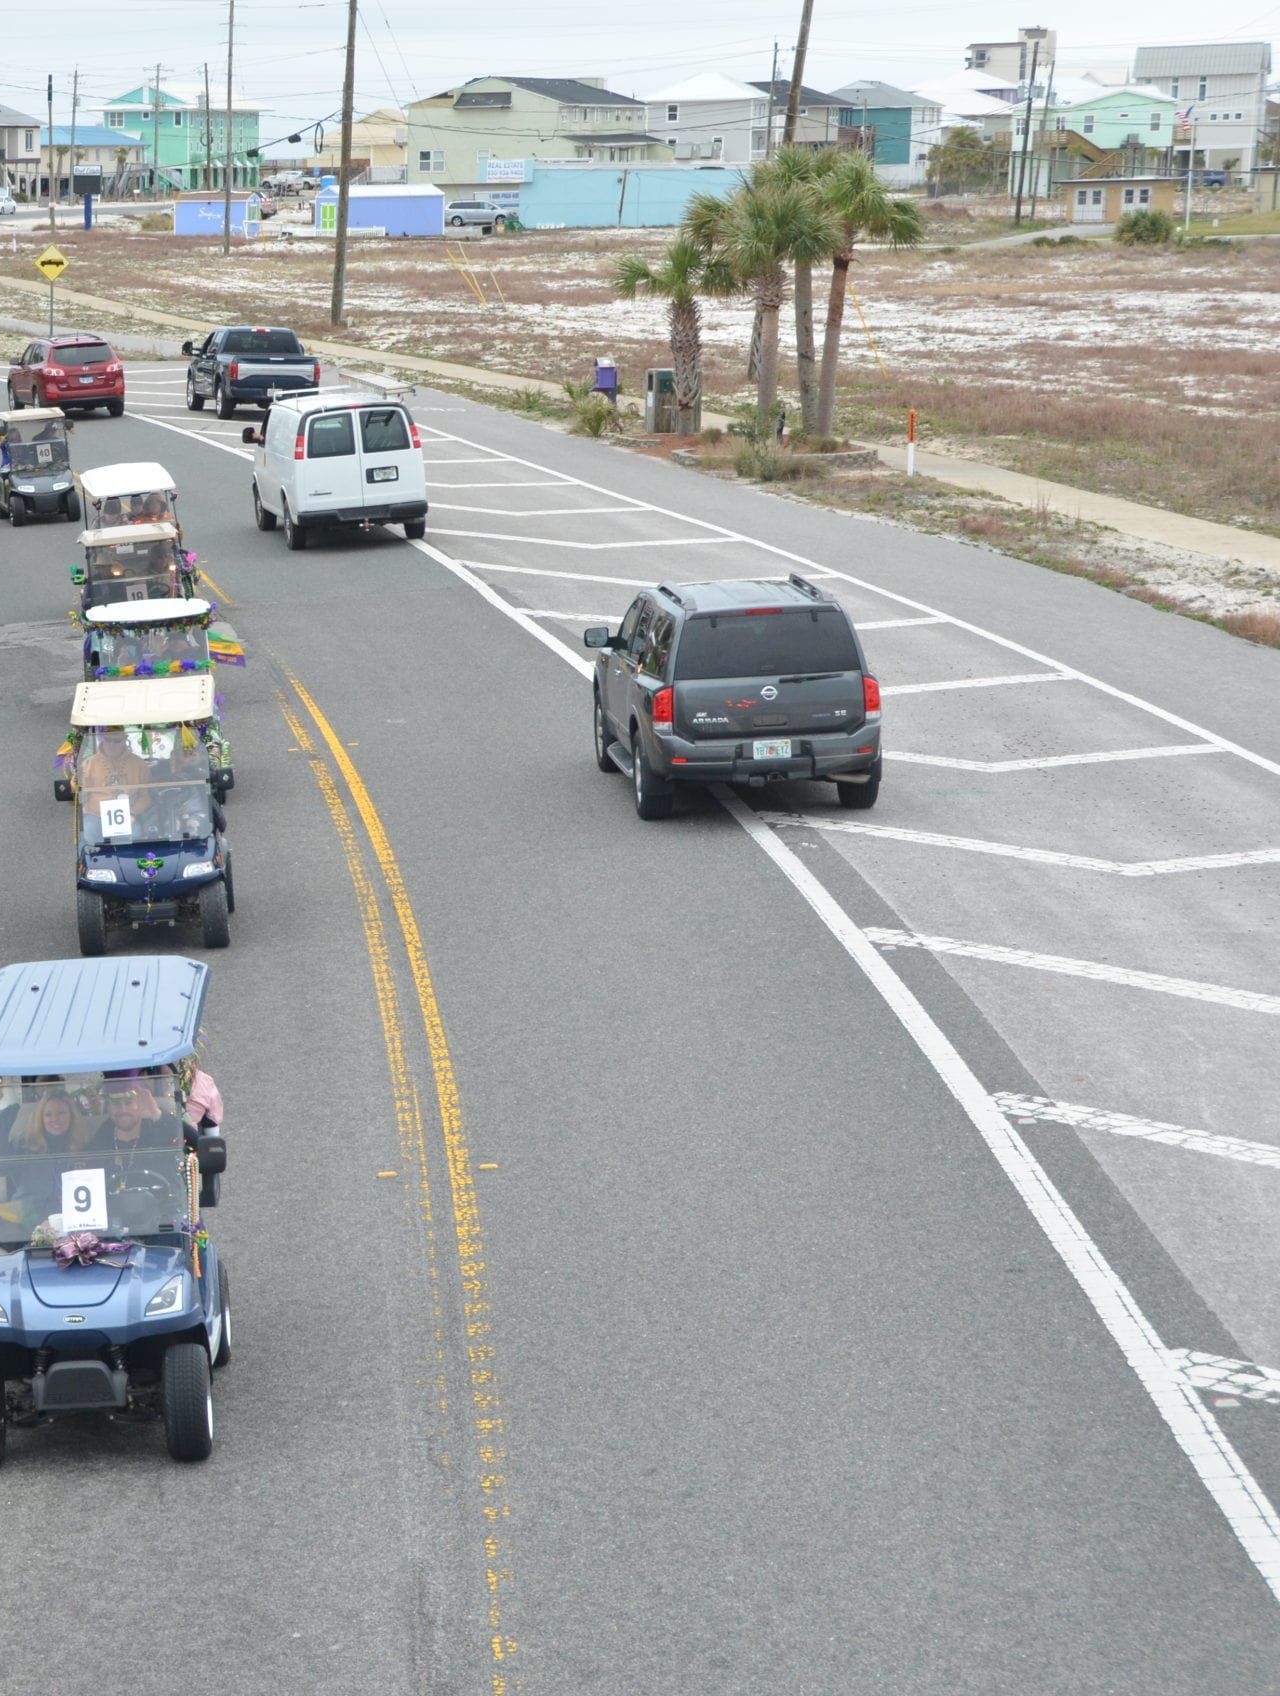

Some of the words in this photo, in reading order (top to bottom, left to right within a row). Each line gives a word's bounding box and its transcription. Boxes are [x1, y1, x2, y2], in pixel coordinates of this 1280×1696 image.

[39, 448, 50, 457] 40
[106, 809, 125, 826] 16
[74, 1185, 92, 1212] 9
